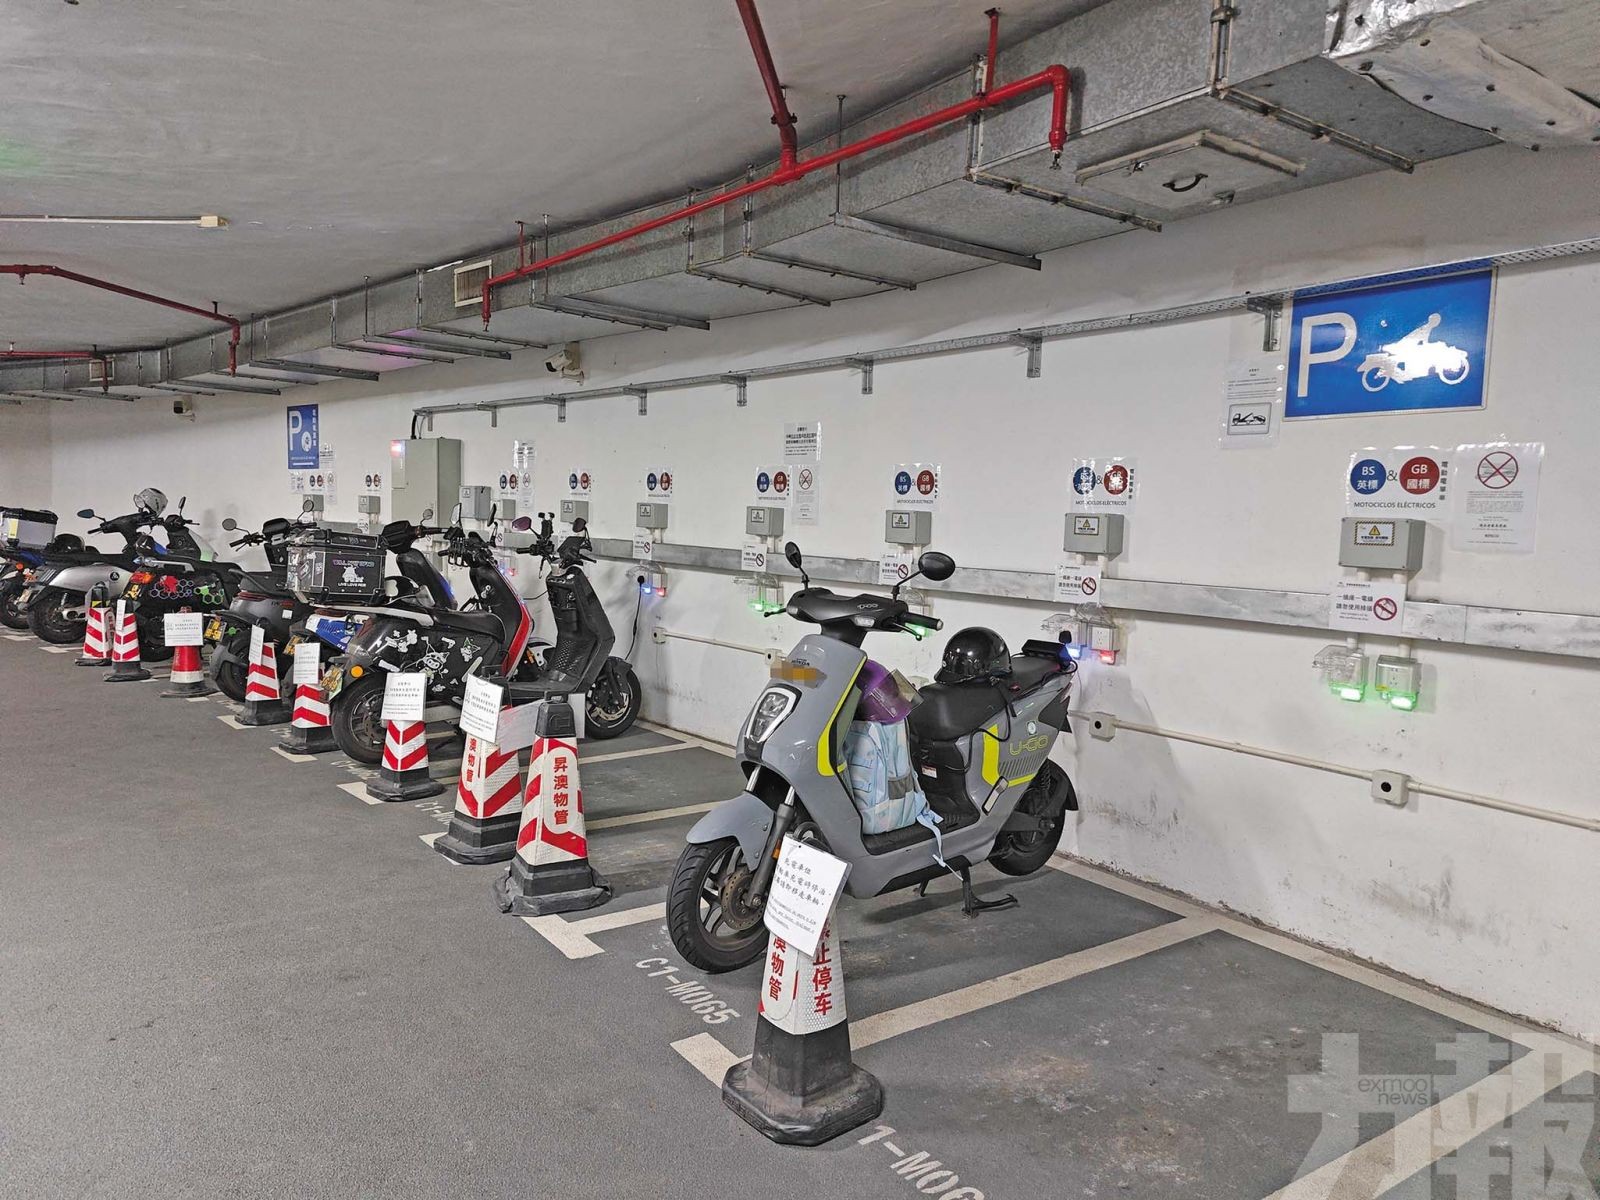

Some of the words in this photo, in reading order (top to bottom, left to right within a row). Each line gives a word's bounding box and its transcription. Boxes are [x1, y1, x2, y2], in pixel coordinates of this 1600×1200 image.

[1297, 311, 1357, 397] P
[289, 410, 302, 451] P
[1361, 466, 1375, 476] BS
[1386, 469, 1398, 481] &
[1411, 464, 1428, 475] GB
[1356, 479, 1379, 490] 英標
[553, 756, 569, 825] 昇澳物管
[635, 957, 741, 1025] C1-M065
